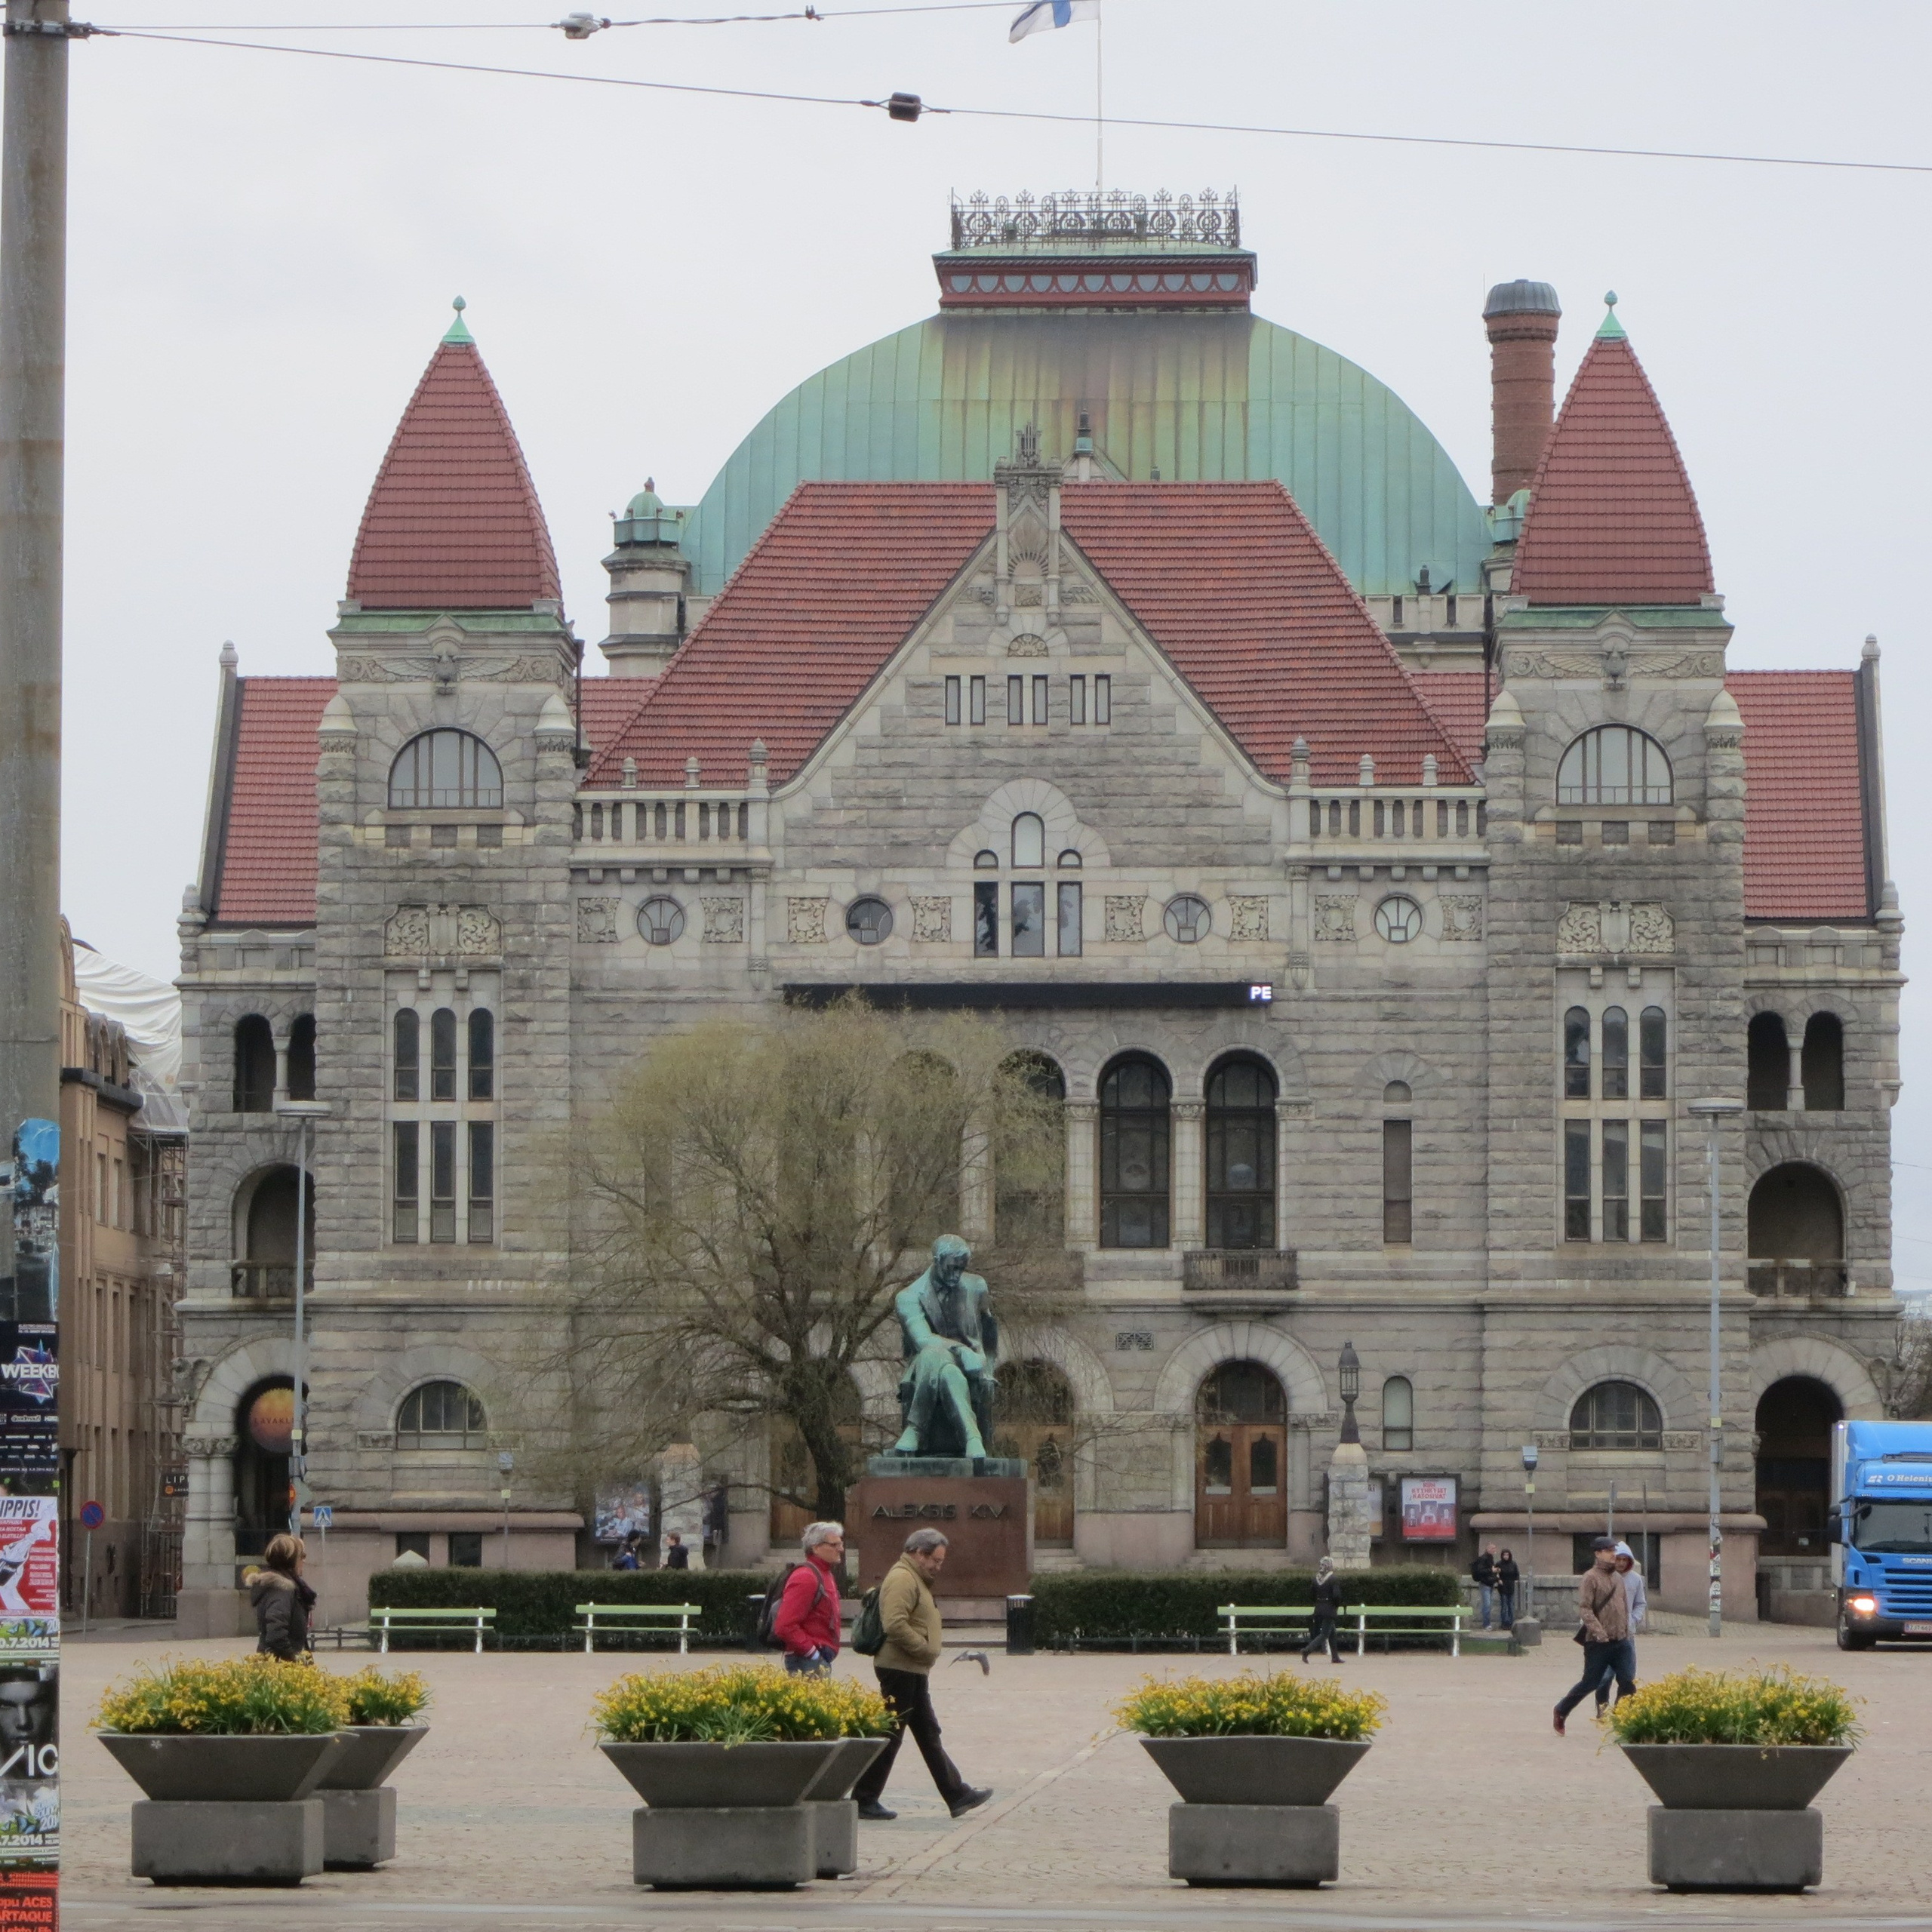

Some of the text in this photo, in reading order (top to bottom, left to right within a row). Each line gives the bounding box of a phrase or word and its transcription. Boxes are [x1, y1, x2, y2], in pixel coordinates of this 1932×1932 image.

[1251, 986, 1272, 1000] PE
[165, 1475, 189, 1484] LIP
[0, 1500, 41, 1518] IPPIS!
[872, 1504, 956, 1518] ALEKSIS
[23, 1897, 52, 1908] ACES
